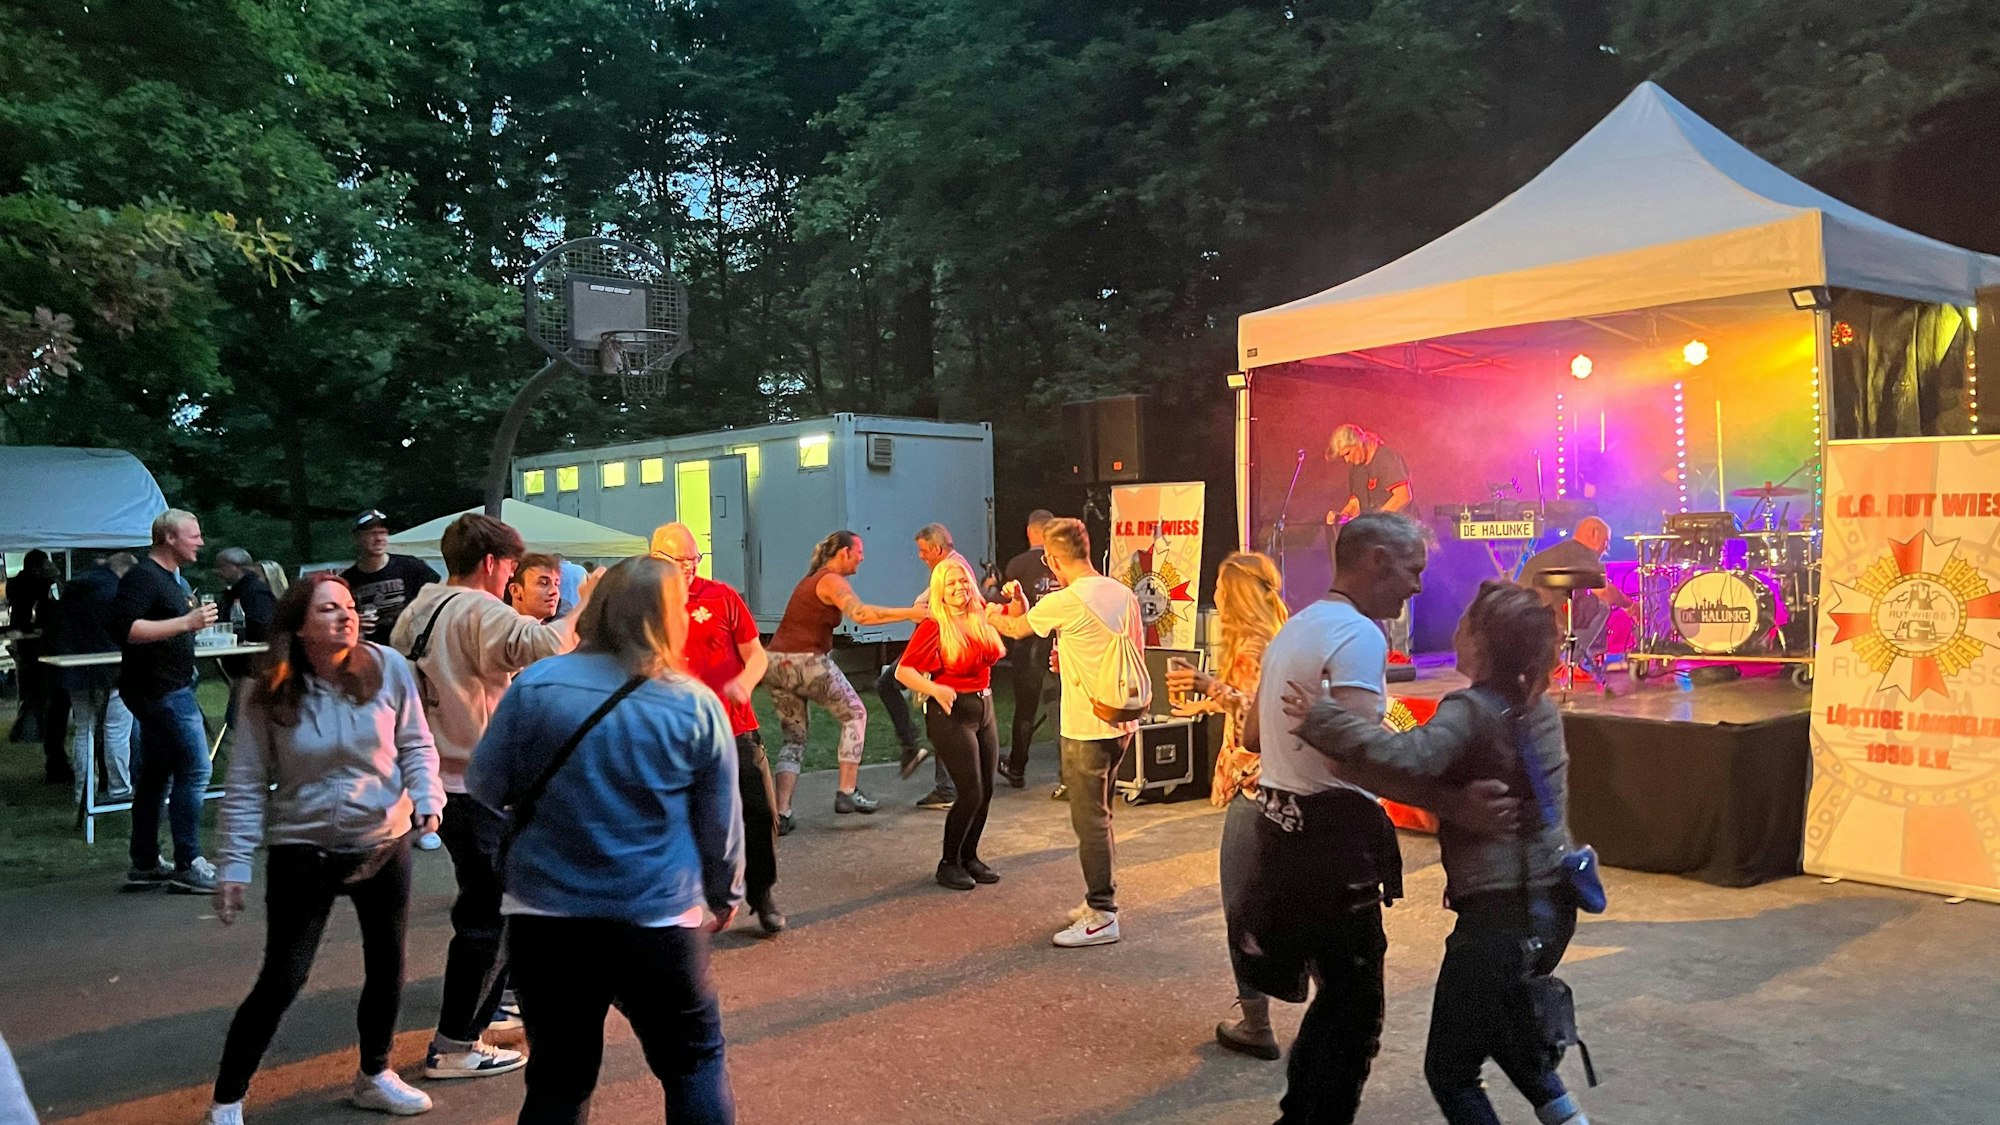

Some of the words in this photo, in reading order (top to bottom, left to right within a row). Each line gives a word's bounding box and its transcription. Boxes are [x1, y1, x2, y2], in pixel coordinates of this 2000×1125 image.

[1837, 494, 1881, 518] K.G.
[1887, 493, 1937, 517] RUT
[1115, 521, 1135, 536] K.G.
[1161, 520, 1199, 536] WIESS
[1463, 525, 1476, 537] DE
[1482, 523, 1531, 536] HALUNKE
[1682, 611, 1695, 622] DE
[1701, 610, 1749, 622] HALUNKE
